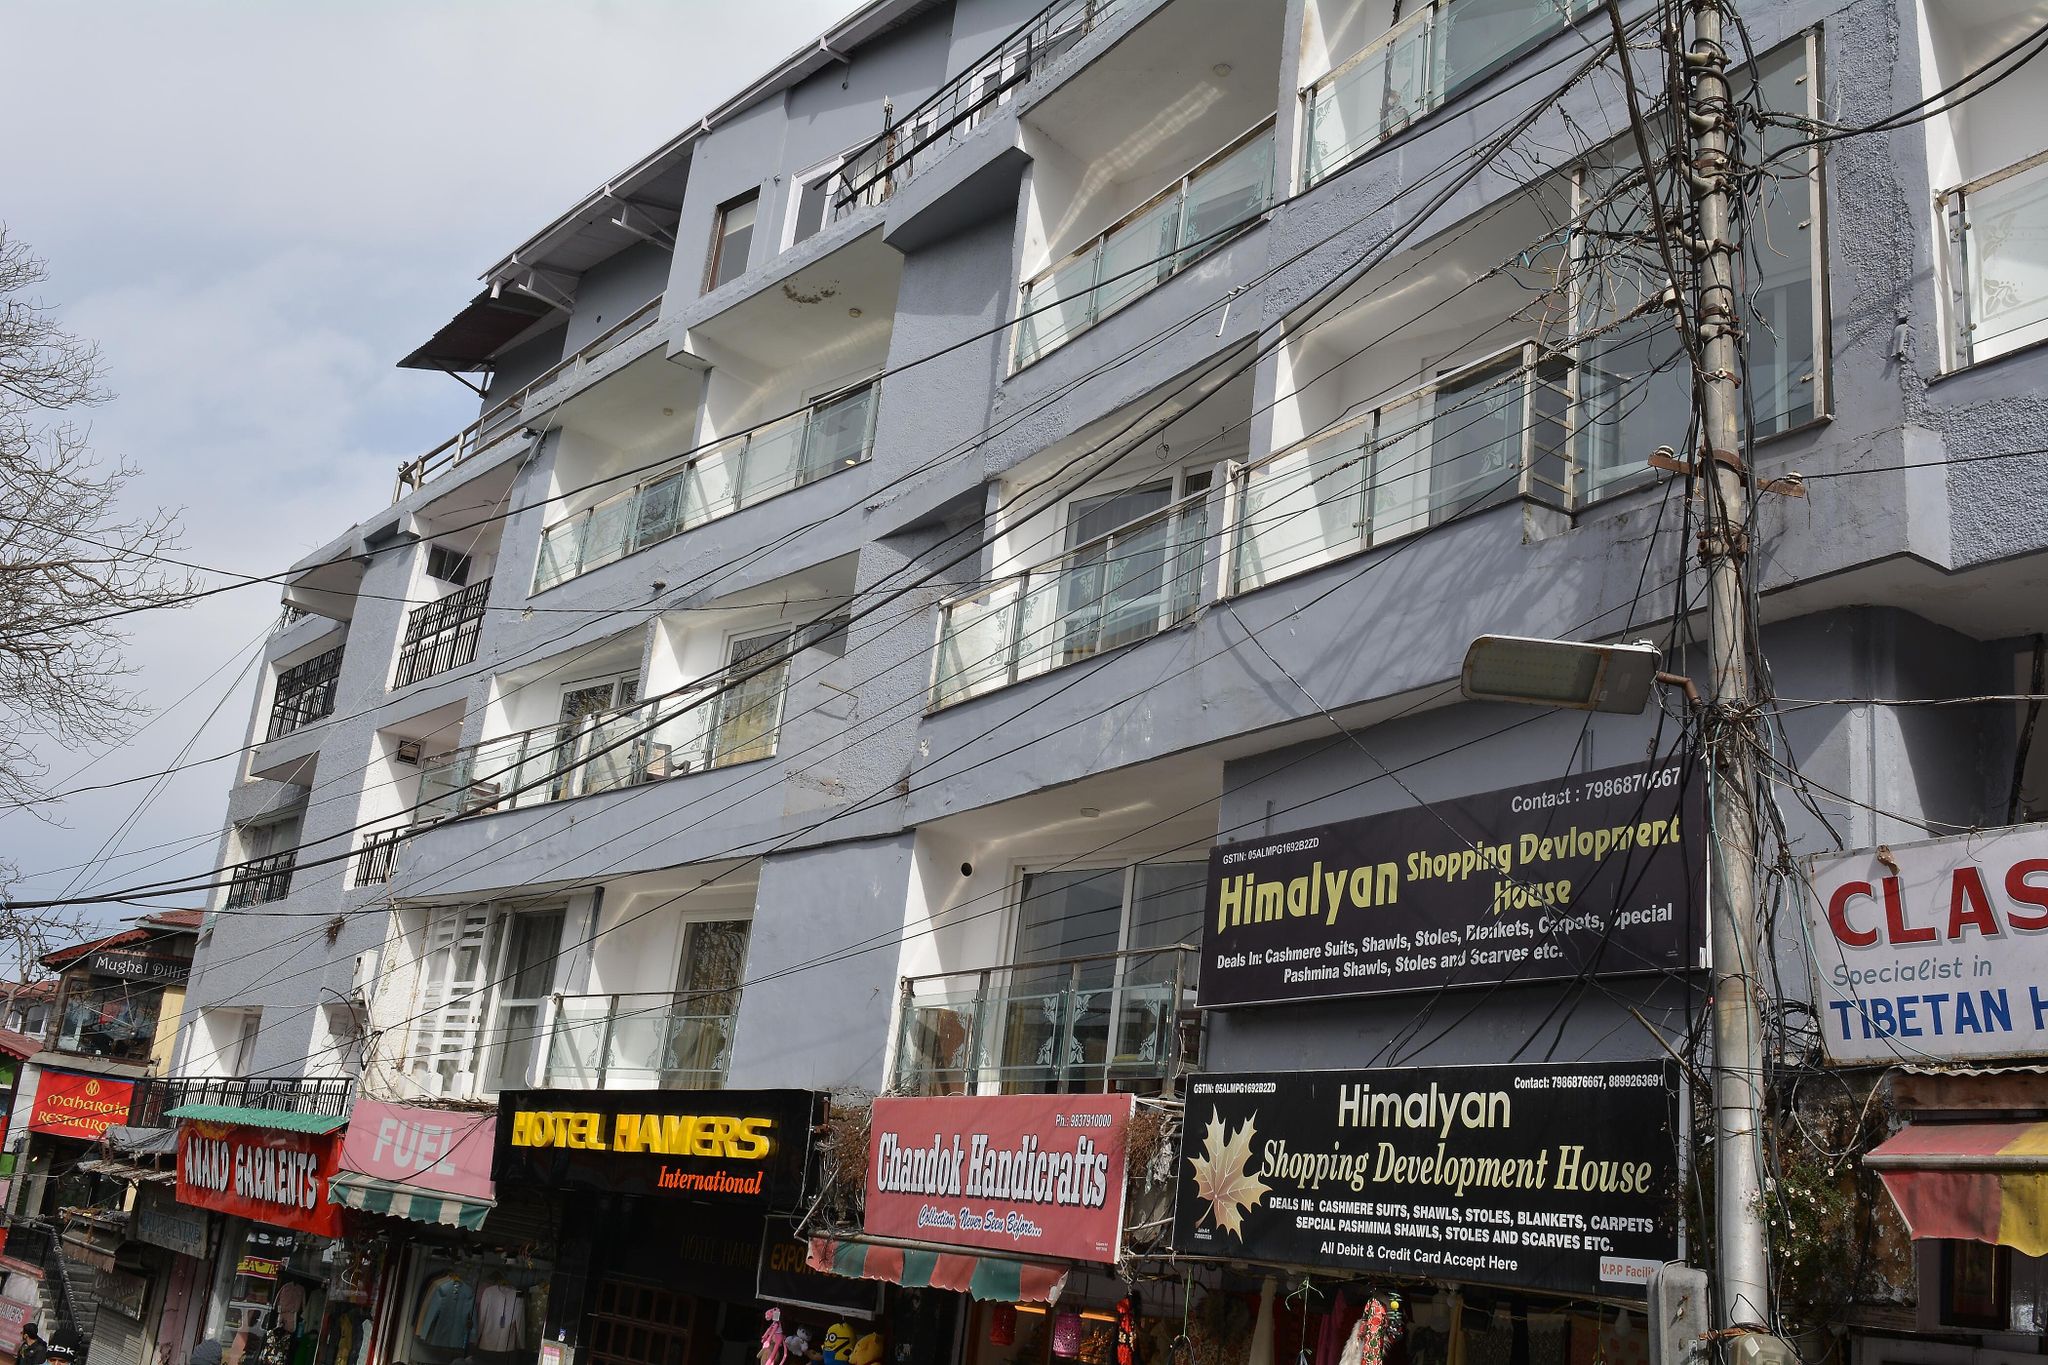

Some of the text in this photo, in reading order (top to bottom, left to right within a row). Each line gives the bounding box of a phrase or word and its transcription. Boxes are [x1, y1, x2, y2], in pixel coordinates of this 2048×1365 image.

[1511, 787, 1571, 813] Contact
[1217, 814, 1681, 935] Himalyan Shopping Devlopment
[1222, 851, 1247, 866] GSTIN:
[1493, 879, 1572, 916] House
[1216, 952, 1246, 969] Deals
[1248, 951, 1263, 966] In:
[1265, 945, 1322, 964] Cashmere
[1324, 941, 1359, 957] Suits,
[1361, 933, 1411, 953] Shawls,
[1414, 928, 1462, 947] Stoles,
[1466, 919, 1534, 941] Blankets,
[1538, 911, 1605, 935] Carpets,
[95, 956, 191, 979] Mughal Dilli-
[1283, 942, 1564, 984] Pashmina Shawls, Stoles and Scarves etc.
[1832, 954, 1992, 991] Specialist in
[1829, 988, 2013, 1040] TIBETAN
[1193, 1083, 1214, 1094] GSTIN:
[1514, 1076, 1550, 1089] Contact:
[1608, 1074, 1664, 1088] 8899263691
[1338, 1082, 1511, 1139] Himalyan
[372, 1116, 456, 1176] FUEL
[511, 1111, 772, 1160] HOTEL HAMERS
[184, 1135, 318, 1210] ANAND GARMENTS
[657, 1165, 764, 1195] International
[877, 1131, 1109, 1209] Chandok Handicrafts
[1260, 1139, 1653, 1197] Shopping Development House
[959, 1206, 982, 1230] Never
[983, 1208, 1004, 1234] Seen
[1005, 1210, 1043, 1240] Before...
[1269, 1196, 1654, 1233] DEALS IN: CASHMERE SUITS, SHAWLS, STOLES, BLANKETS, CARPETS
[1295, 1215, 1614, 1252] SEPCIAL PASHMINA SHAWLS, STOLES AND SCARVES ETC.
[1320, 1240, 1518, 1271] All Debit & Credit Card Accept Here
[1601, 1262, 1655, 1279] V.P.P Facilit
